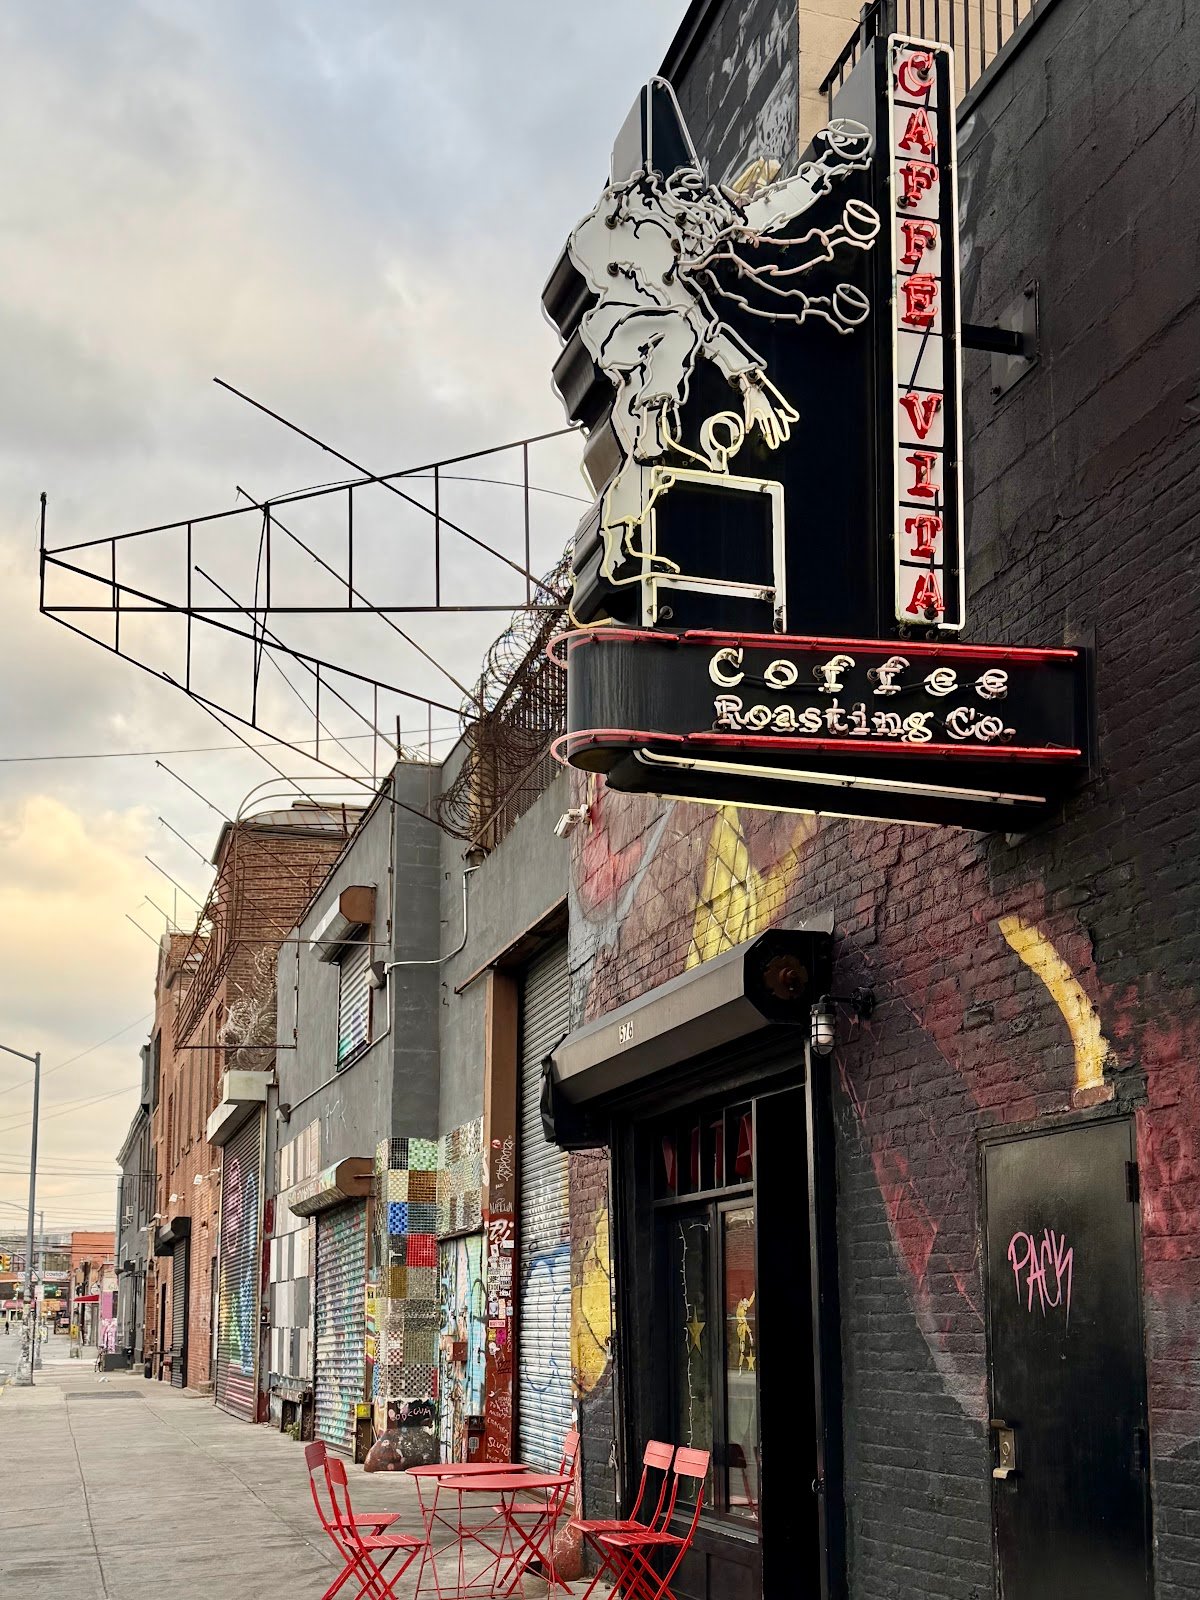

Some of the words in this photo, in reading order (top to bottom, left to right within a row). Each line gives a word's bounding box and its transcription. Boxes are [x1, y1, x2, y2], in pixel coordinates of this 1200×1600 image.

[897, 51, 939, 327] CAFFE
[899, 392, 945, 615] VITA
[708, 647, 1009, 700] Coffee
[713, 694, 934, 742] Roasting
[945, 706, 1017, 741] Co.
